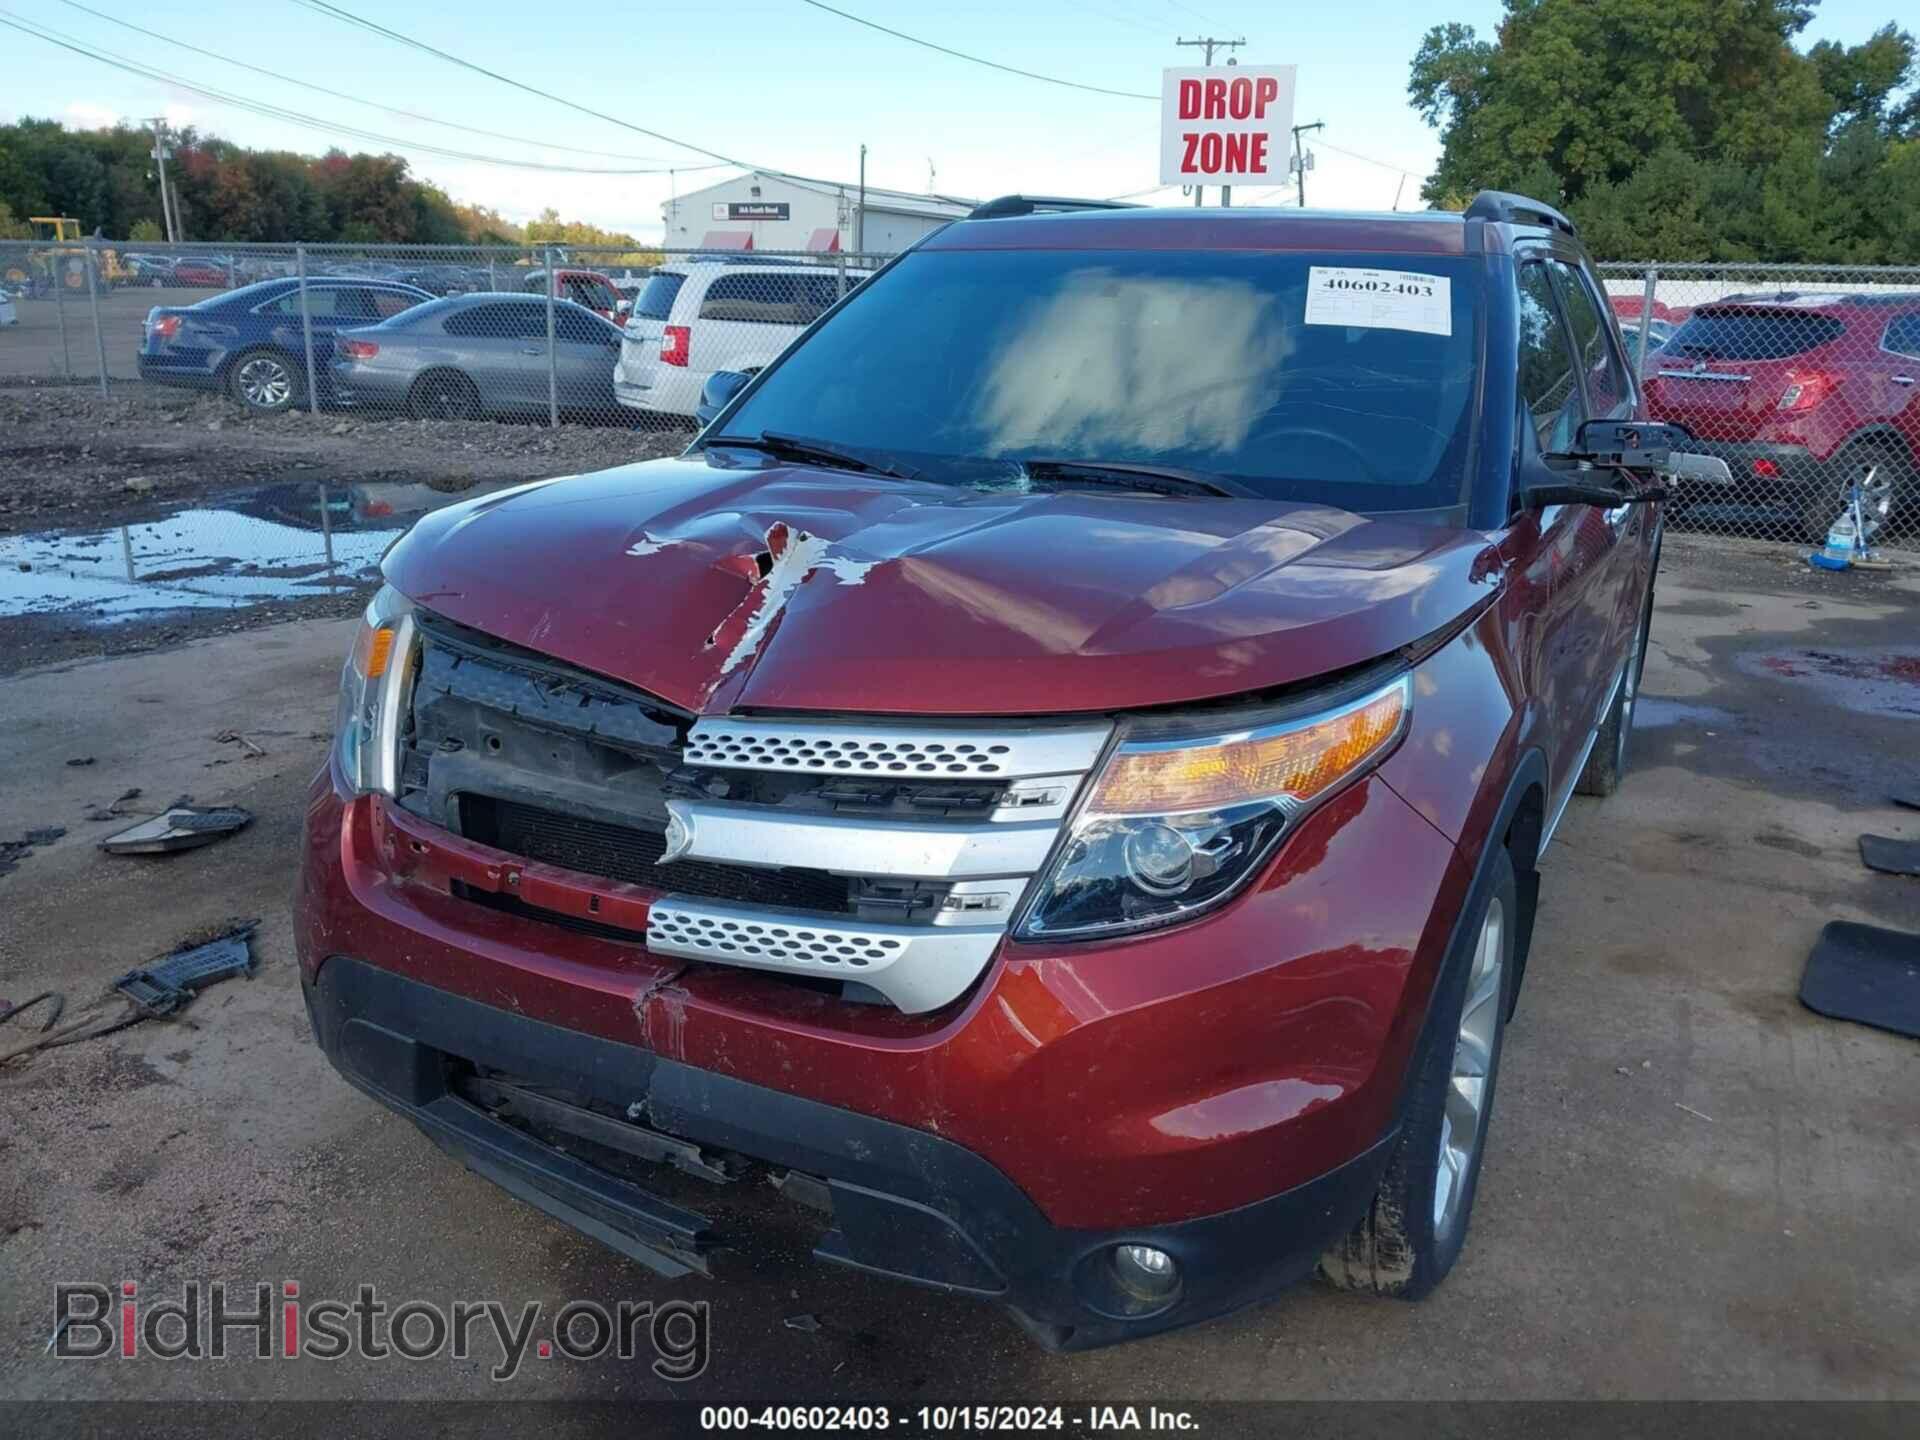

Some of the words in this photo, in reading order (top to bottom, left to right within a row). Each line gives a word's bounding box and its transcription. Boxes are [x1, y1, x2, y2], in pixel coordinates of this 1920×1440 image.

[1179, 77, 1278, 120] DROP
[1181, 132, 1268, 174] ZONE
[1322, 278, 1433, 297] 40602403
